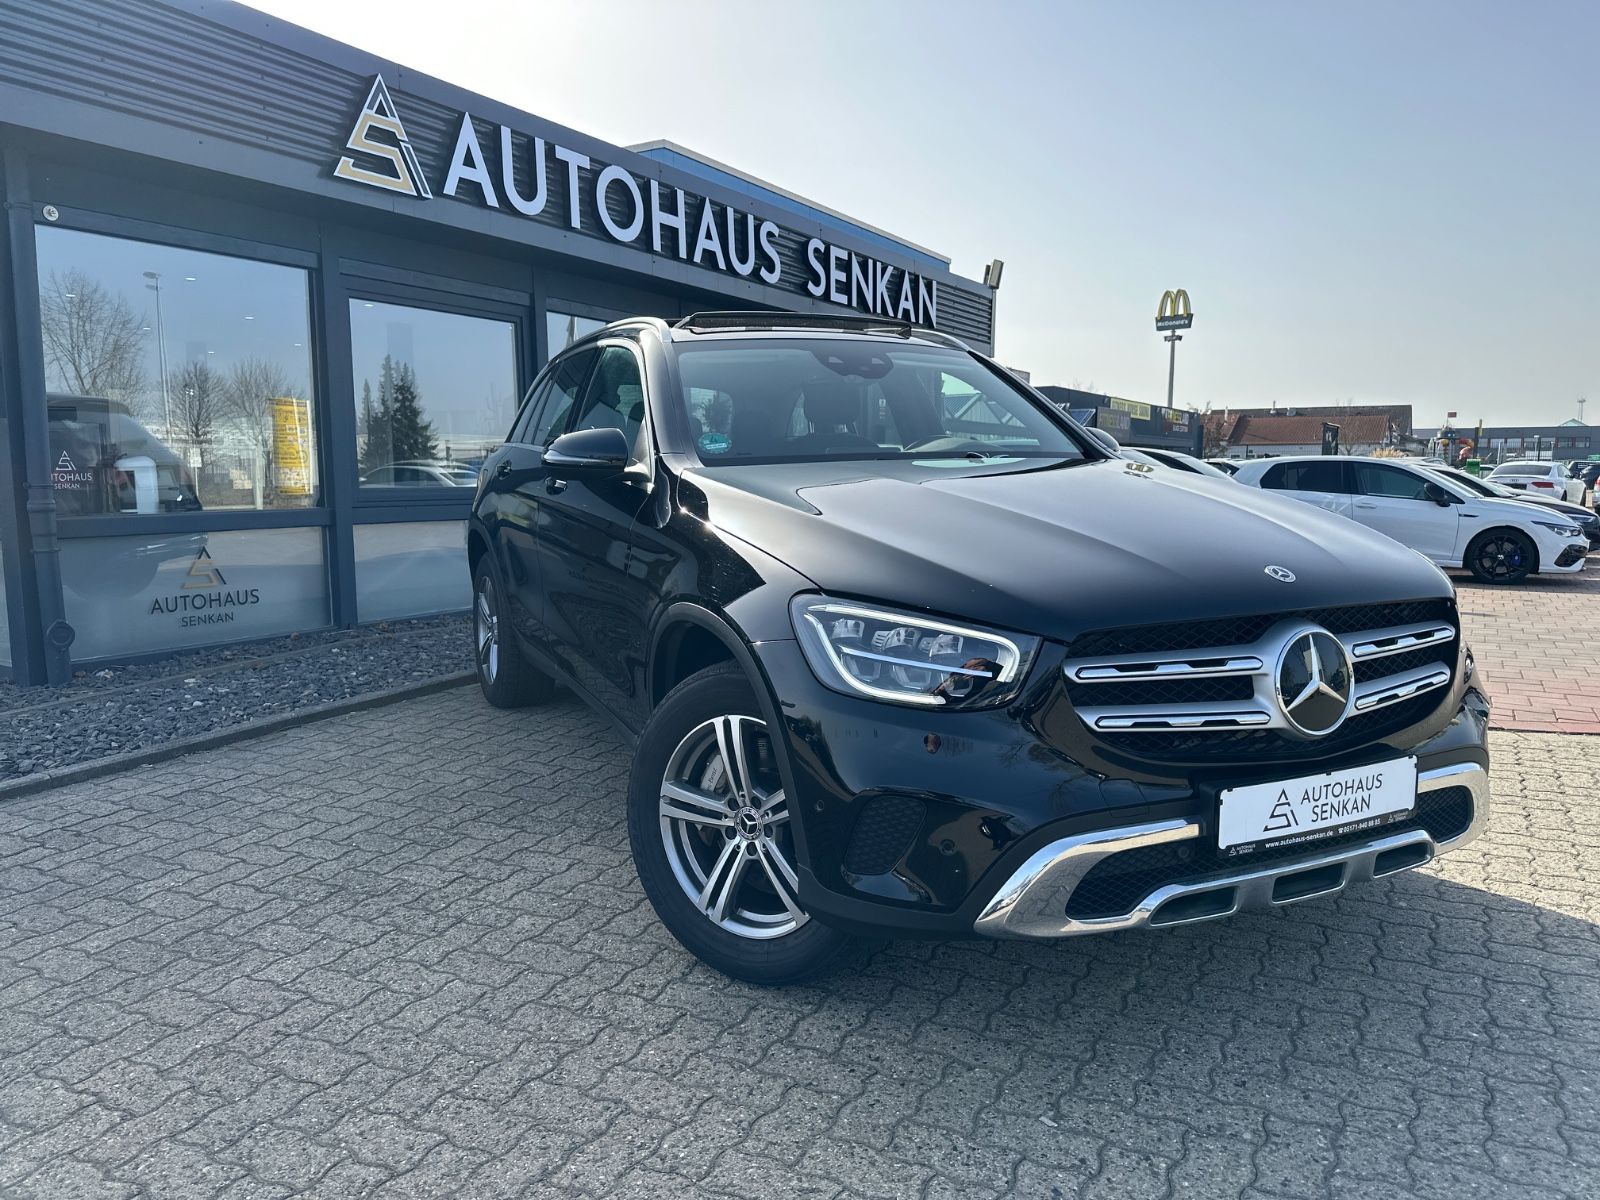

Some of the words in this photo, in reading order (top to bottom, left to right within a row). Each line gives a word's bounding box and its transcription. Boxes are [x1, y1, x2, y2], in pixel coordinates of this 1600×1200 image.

[442, 111, 782, 285] AUTOHAUS
[807, 238, 938, 329] SENKAN
[54, 482, 81, 490] SENKAN
[150, 588, 260, 615] AUTOHAUS
[181, 611, 234, 628] SENKAN
[1300, 773, 1383, 805] AUTOHAUS
[1311, 794, 1371, 823] SENKAN
[1265, 830, 1334, 849] www.autohaus-senkan.de
